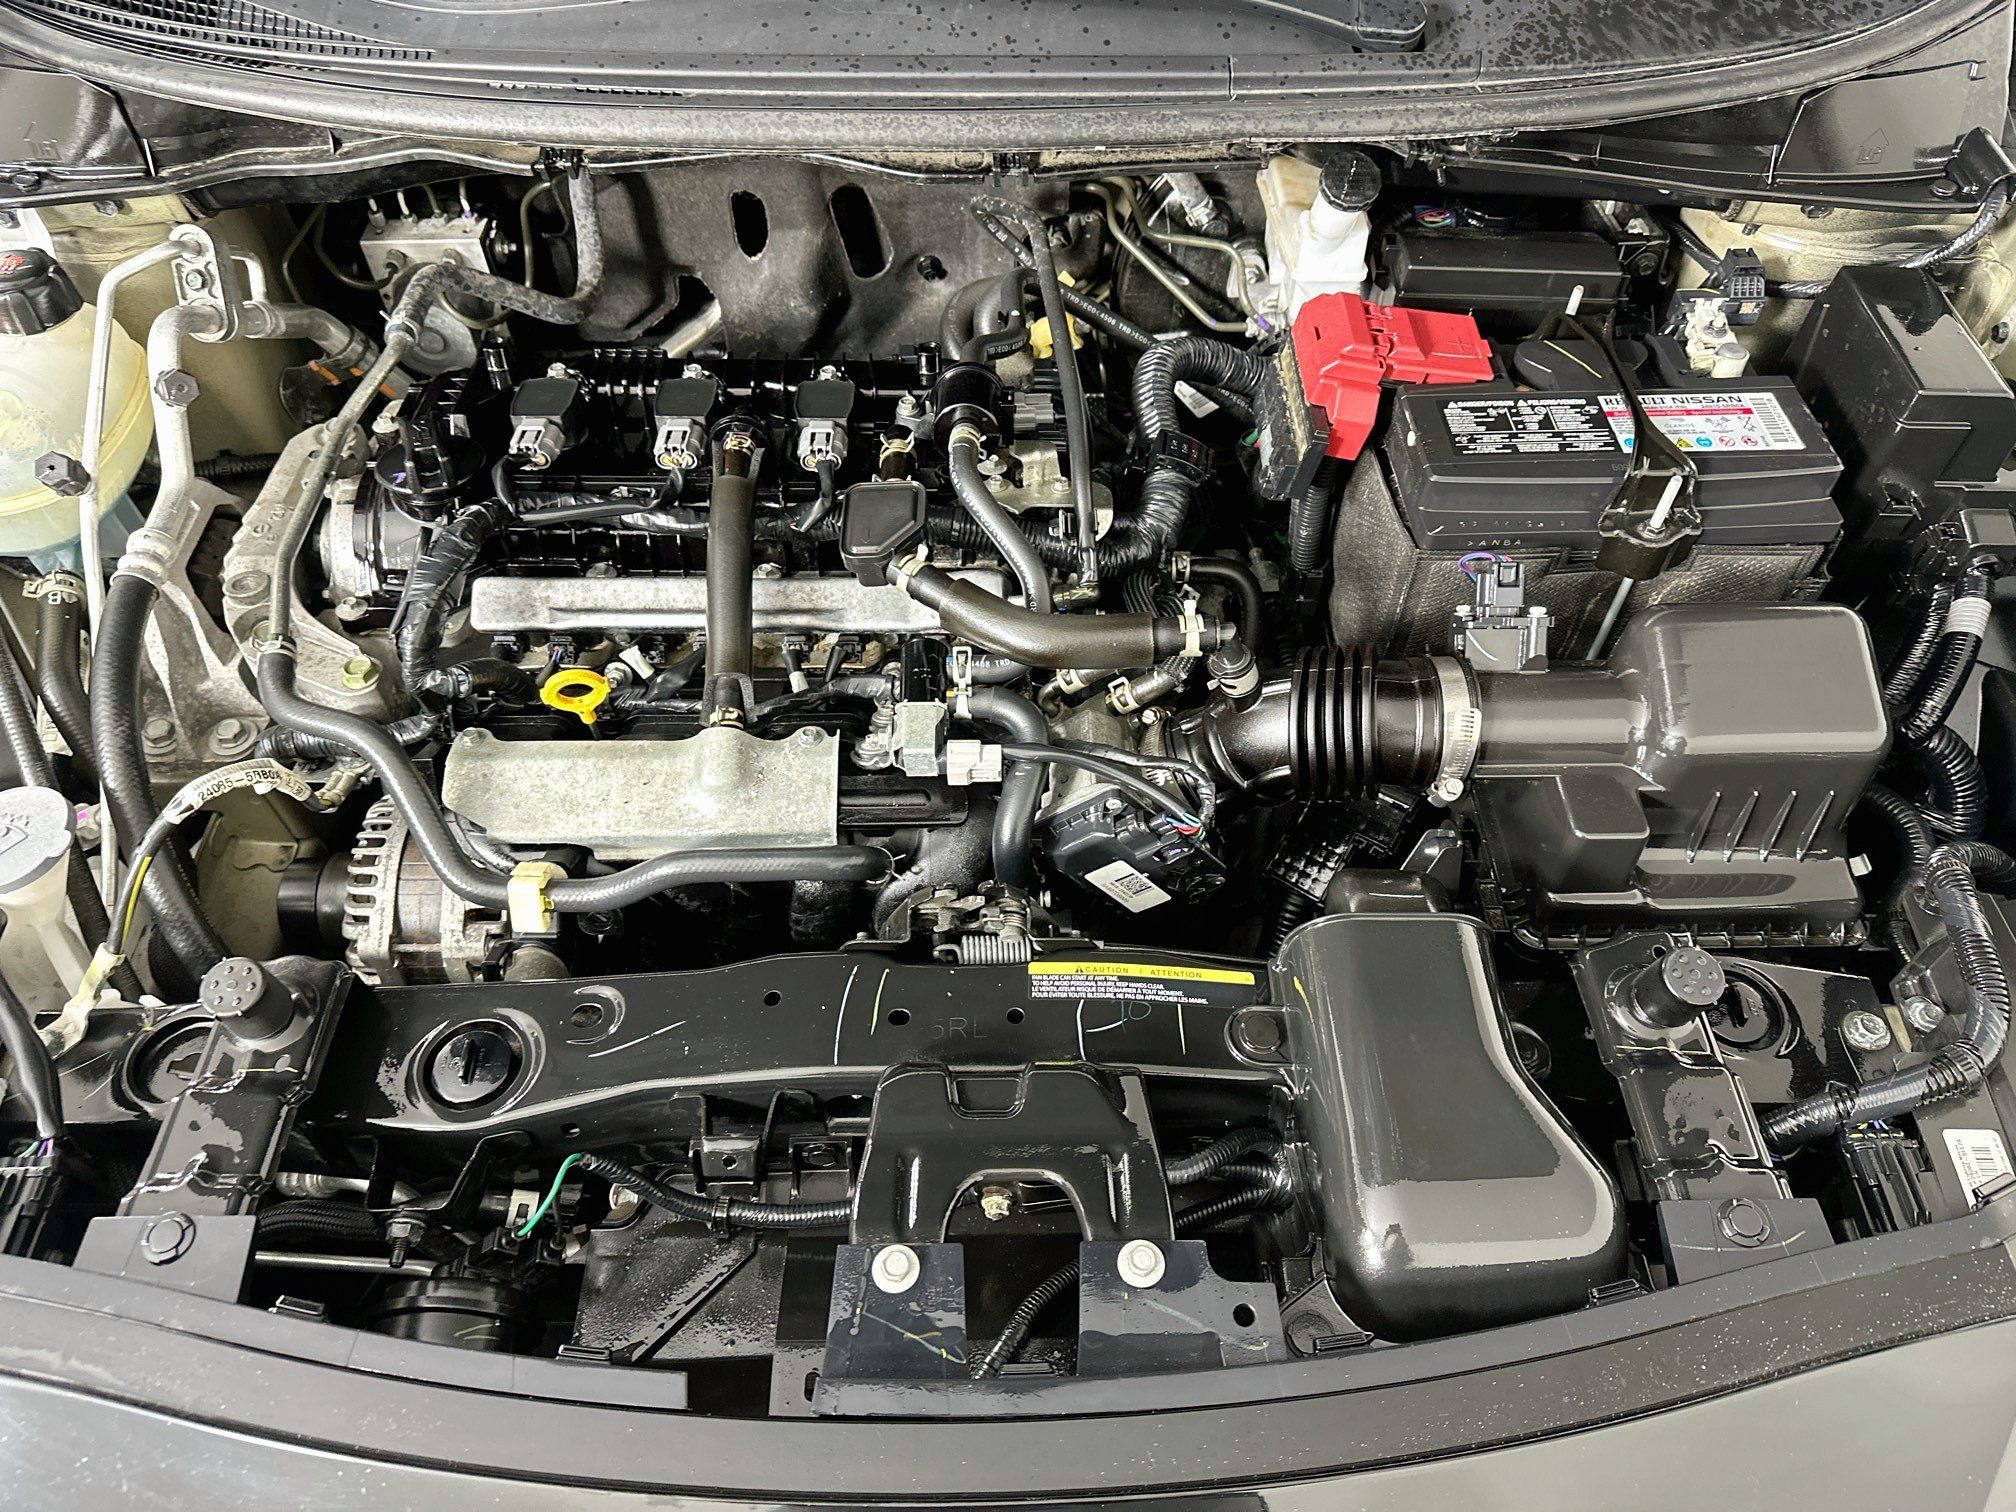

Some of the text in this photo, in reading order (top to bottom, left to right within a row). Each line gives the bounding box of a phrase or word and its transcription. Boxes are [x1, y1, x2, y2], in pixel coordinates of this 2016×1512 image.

[1603, 395, 1743, 405] REULT NISSAN
[1085, 966, 1129, 974] CAUTION
[1150, 969, 1202, 978] ATTENTION
